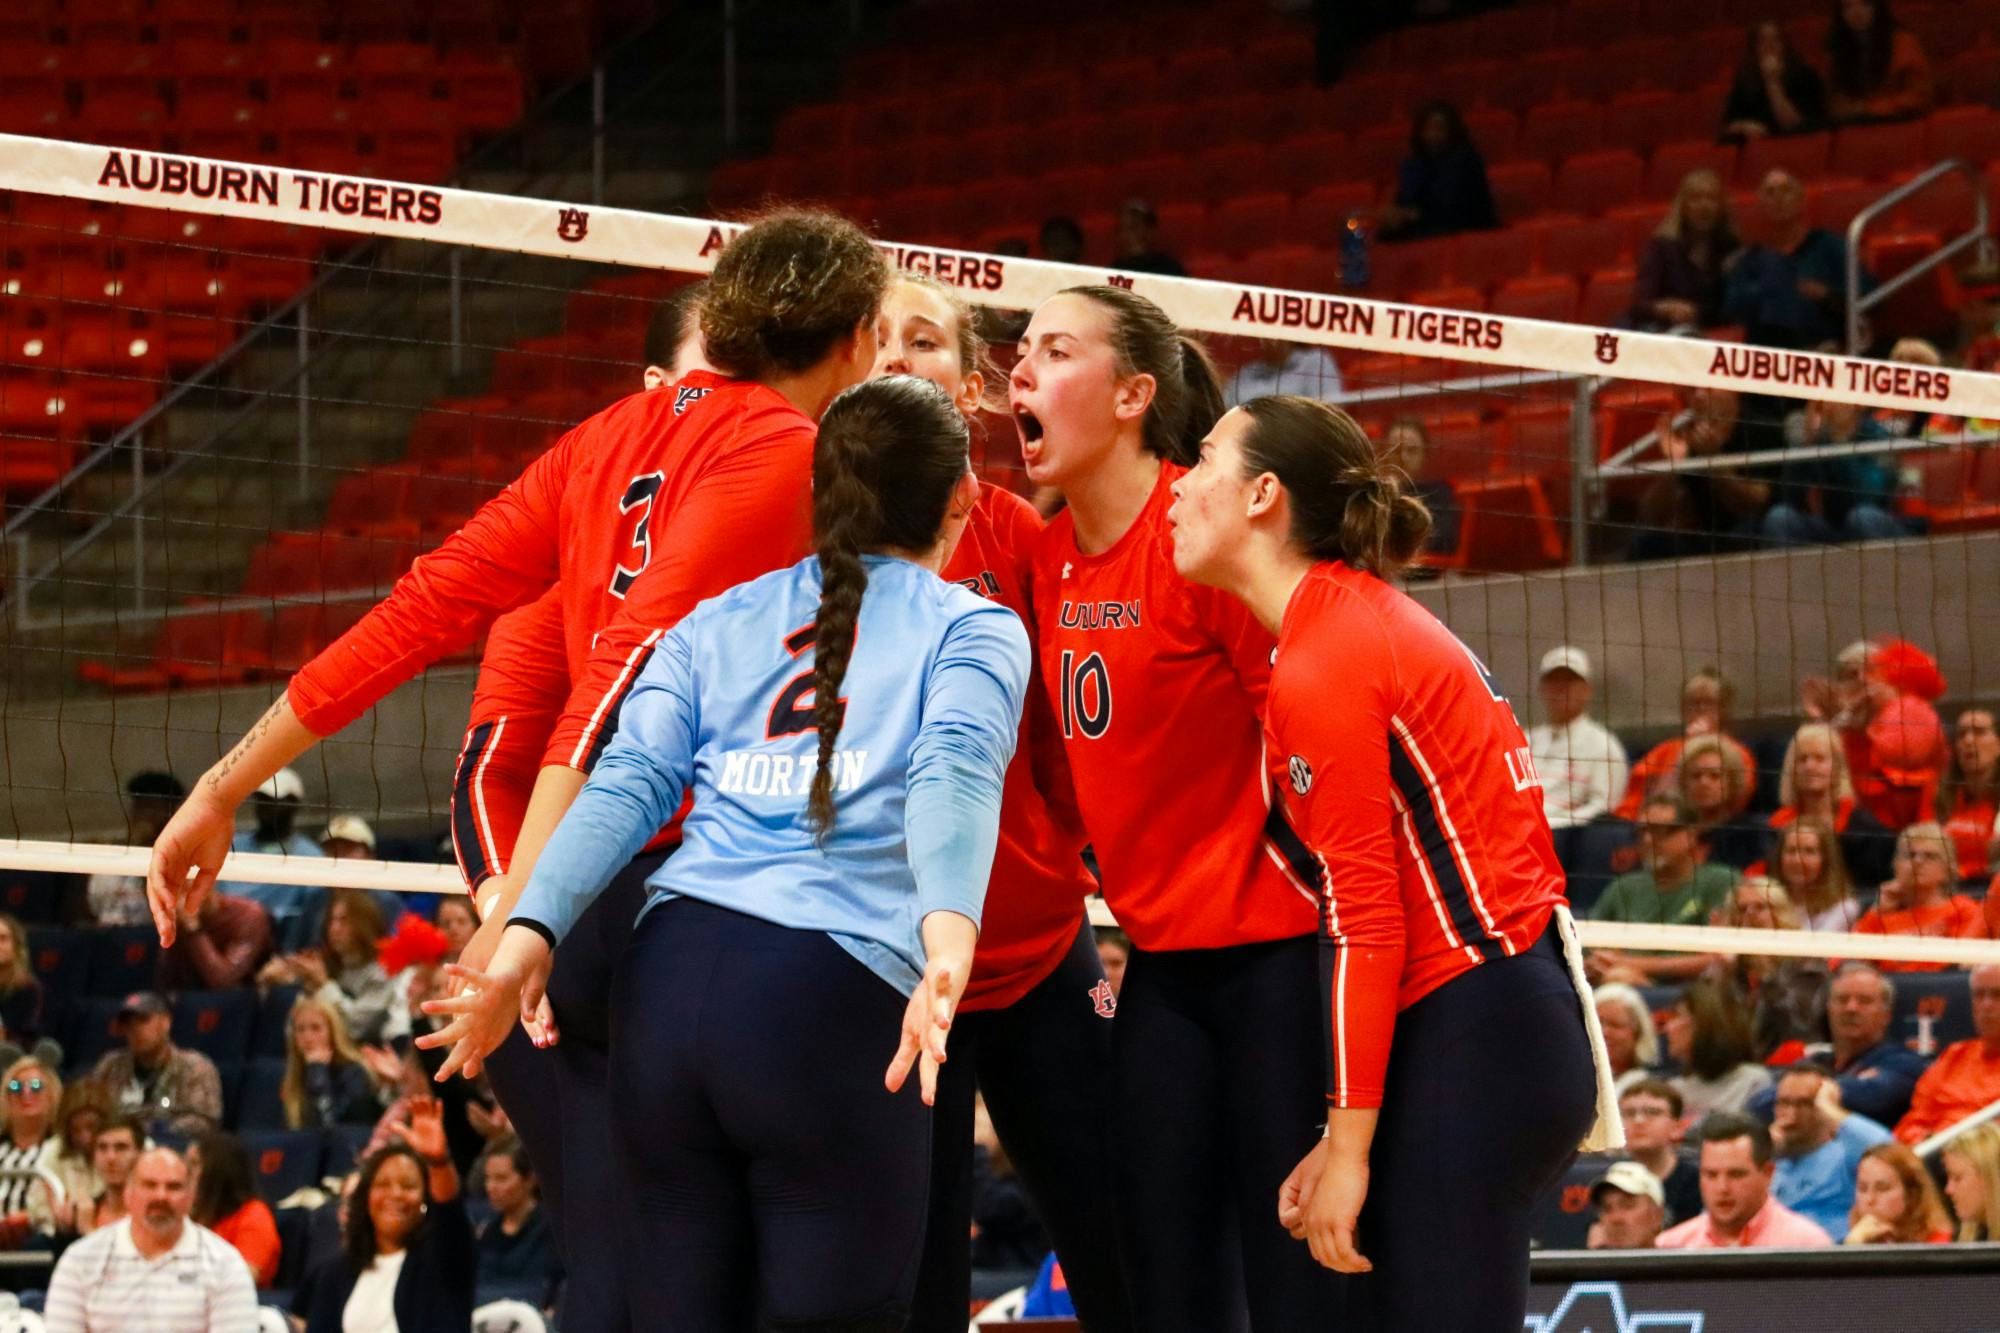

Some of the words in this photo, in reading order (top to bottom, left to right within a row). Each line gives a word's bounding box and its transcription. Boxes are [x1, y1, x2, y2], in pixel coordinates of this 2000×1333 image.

[98, 151, 279, 207] AUBURN
[293, 174, 443, 226] TIGERS
[887, 246, 1004, 291] IGERS
[1232, 290, 1375, 336] AUBURN
[1387, 308, 1503, 349] TIGERS
[1709, 345, 1835, 390] AUBURN
[1845, 362, 1951, 401] TIGERS
[608, 469, 666, 600] 3
[765, 615, 859, 742] 2
[1060, 649, 1113, 740] 10
